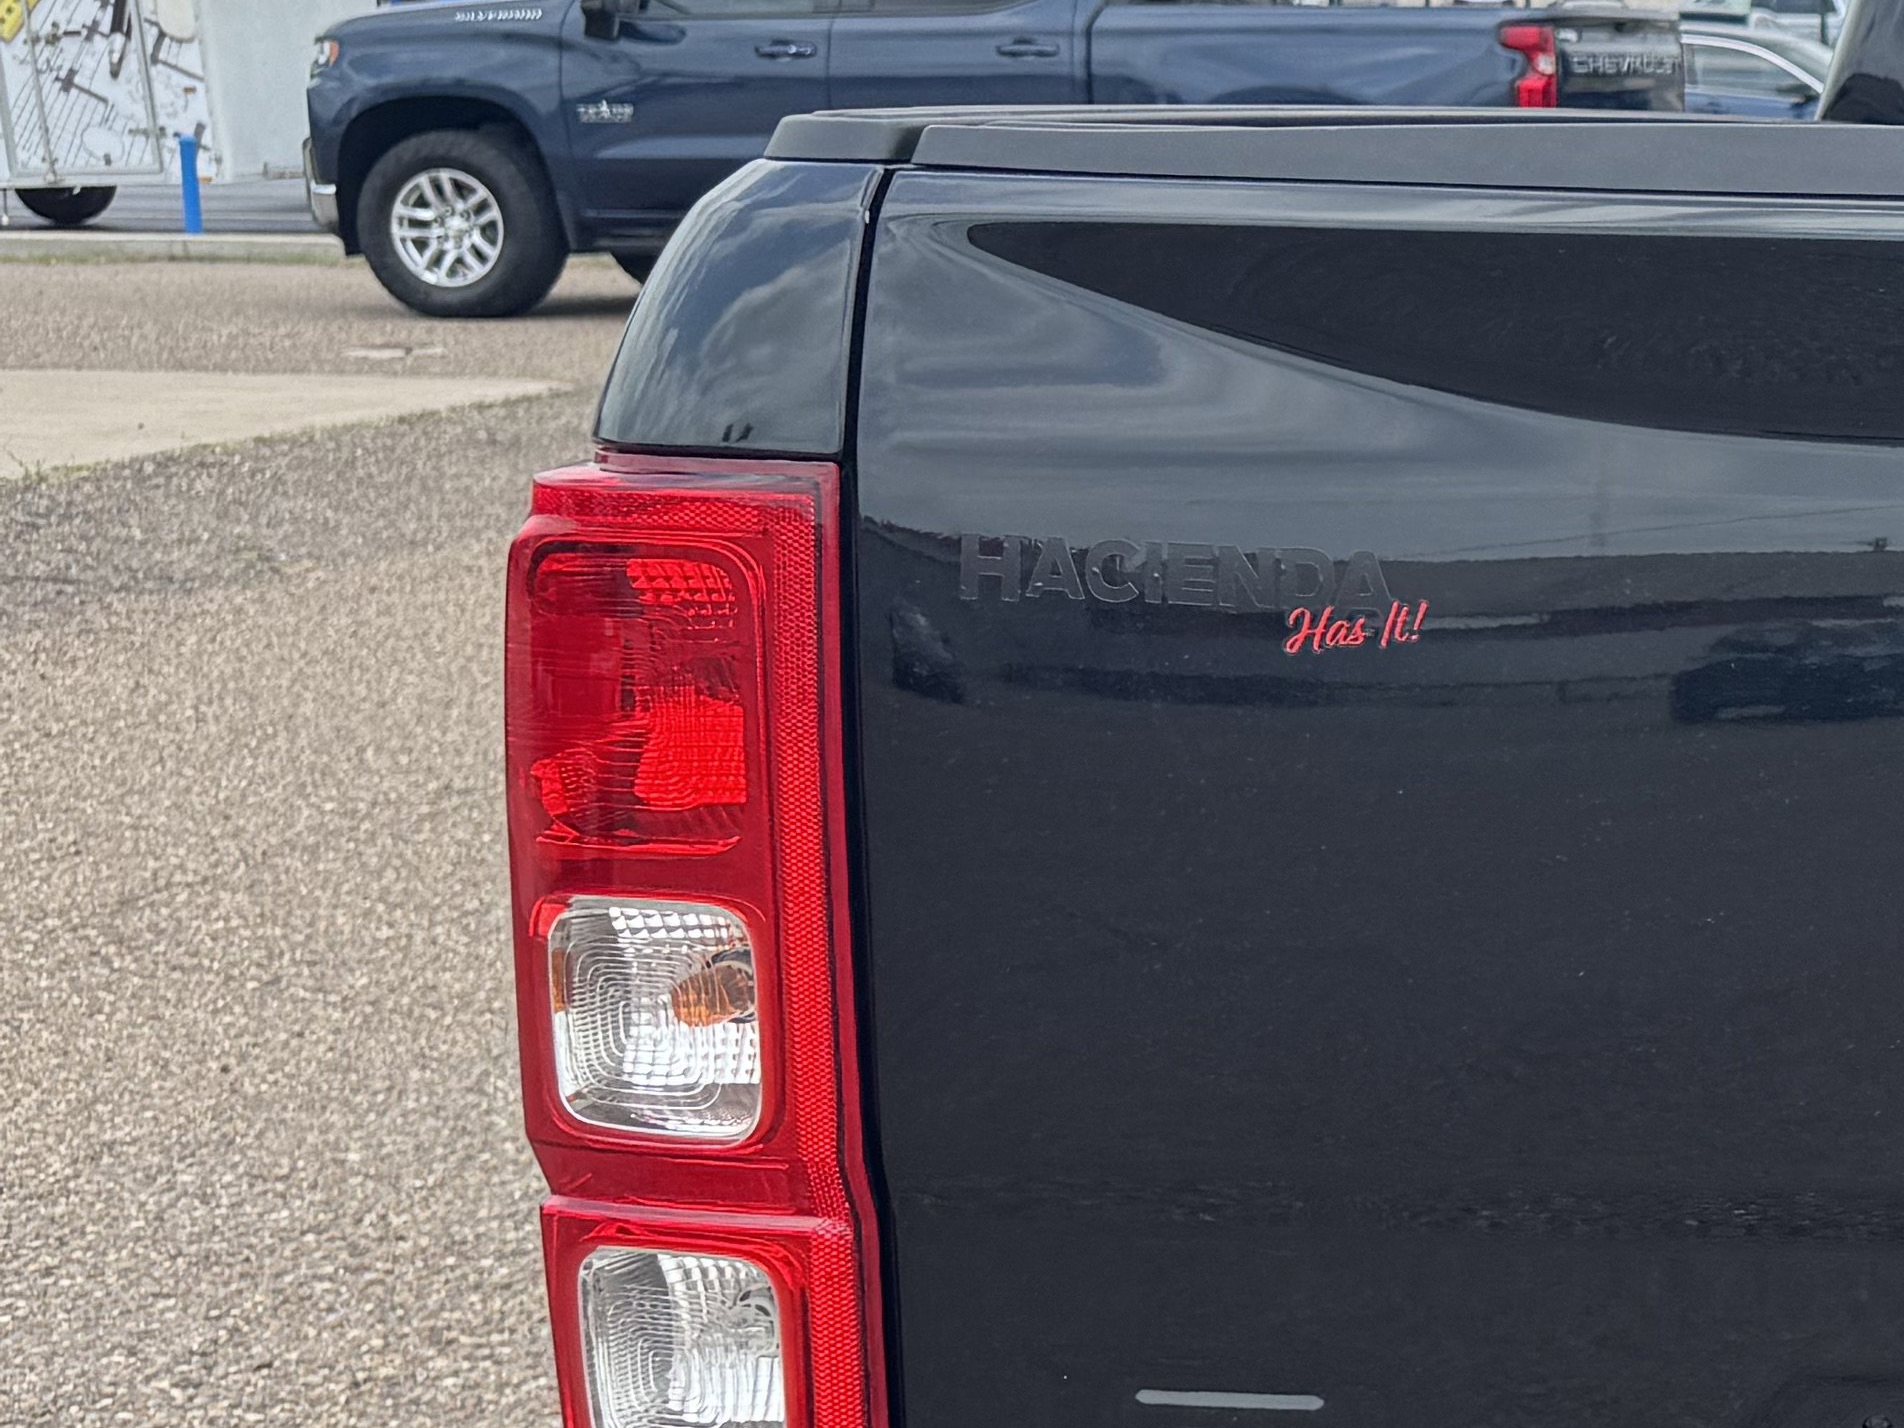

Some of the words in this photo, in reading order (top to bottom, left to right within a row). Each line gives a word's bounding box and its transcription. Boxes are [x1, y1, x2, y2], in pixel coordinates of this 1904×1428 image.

[960, 533, 1400, 616] HACIENDA
[1284, 605, 1367, 655] Has
[1378, 600, 1430, 649] It!
